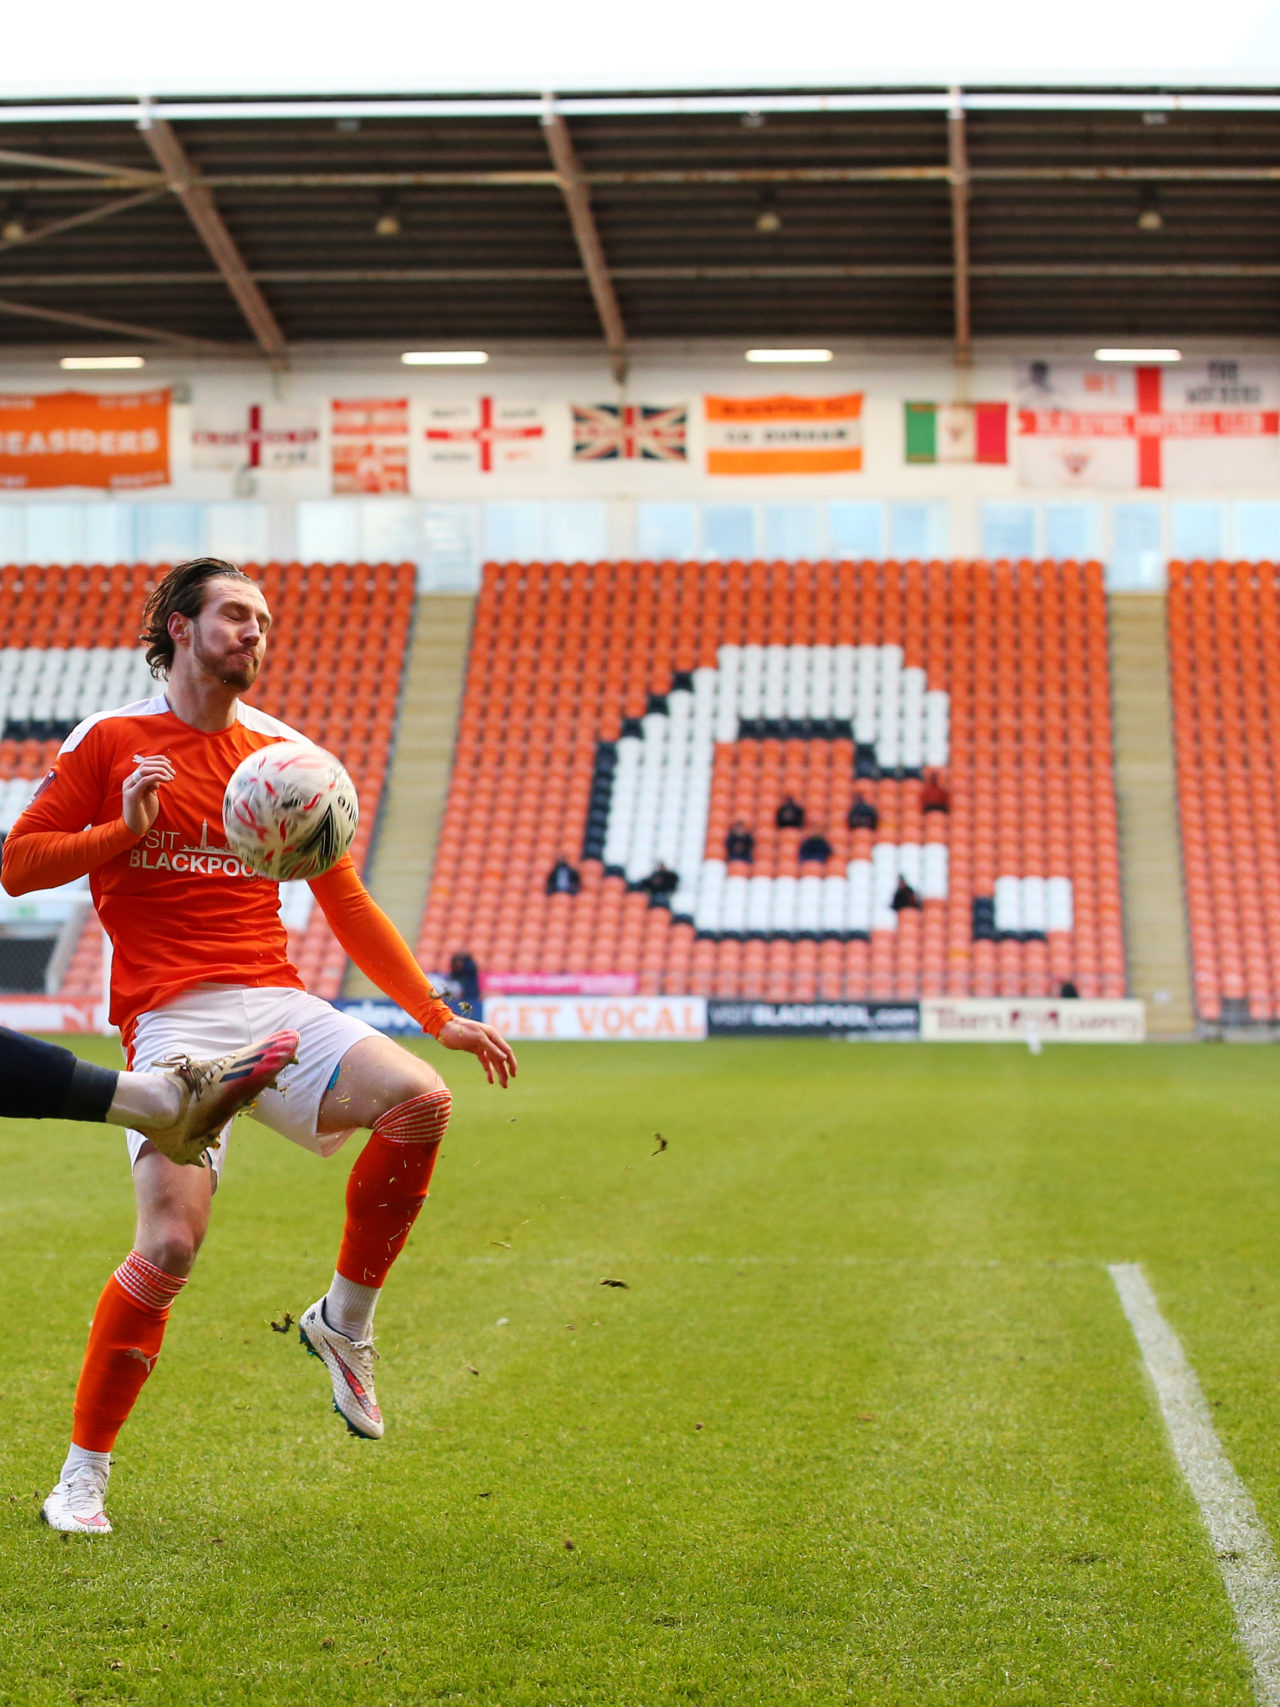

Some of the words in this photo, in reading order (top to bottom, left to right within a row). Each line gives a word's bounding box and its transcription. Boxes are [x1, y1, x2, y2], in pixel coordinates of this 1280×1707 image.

[145, 829, 180, 850] SIT
[129, 849, 258, 878] BLACKPOO
[490, 1005, 562, 1037] GET
[576, 1005, 703, 1037] VOCAL
